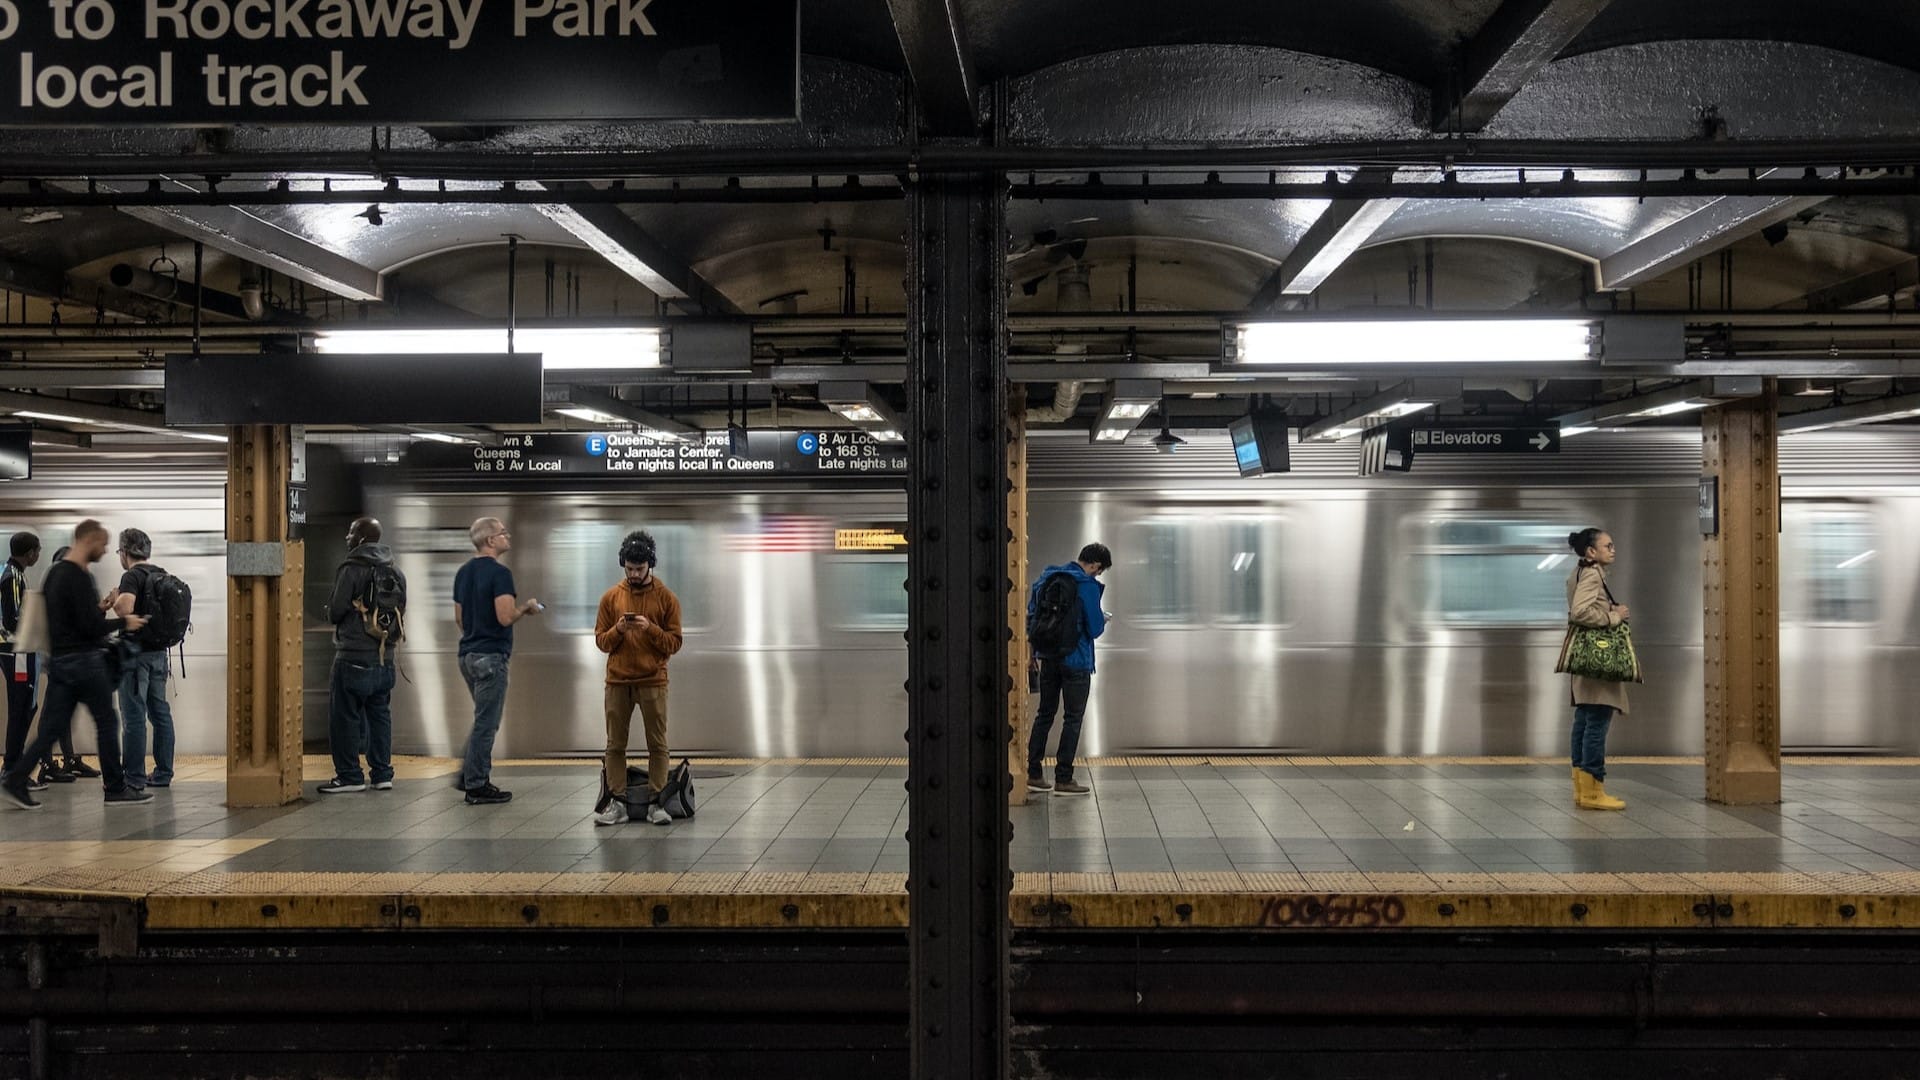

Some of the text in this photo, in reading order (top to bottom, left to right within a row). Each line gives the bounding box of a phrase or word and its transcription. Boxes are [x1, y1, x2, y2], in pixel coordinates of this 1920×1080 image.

[48, 0, 115, 40] to
[145, 0, 483, 49] Rockaway
[514, 0, 657, 37] Park
[20, 51, 369, 107] local track
[606, 434, 654, 447] Queens
[705, 435, 730, 446] pres
[818, 433, 878, 445] 8 Av Loc
[1430, 430, 1502, 445] Elevators
[591, 438, 602, 451] E
[802, 438, 813, 451] C
[819, 445, 880, 457] to 168 St.
[473, 447, 521, 459] Queens
[607, 447, 724, 458] to Jamaica Center.
[474, 459, 562, 471] via 8 Av Local
[606, 458, 775, 473] Late nights local in Queens
[818, 458, 846, 470] Late
[850, 458, 886, 472] nights
[290, 490, 299, 509] 14
[290, 510, 306, 524] Street
